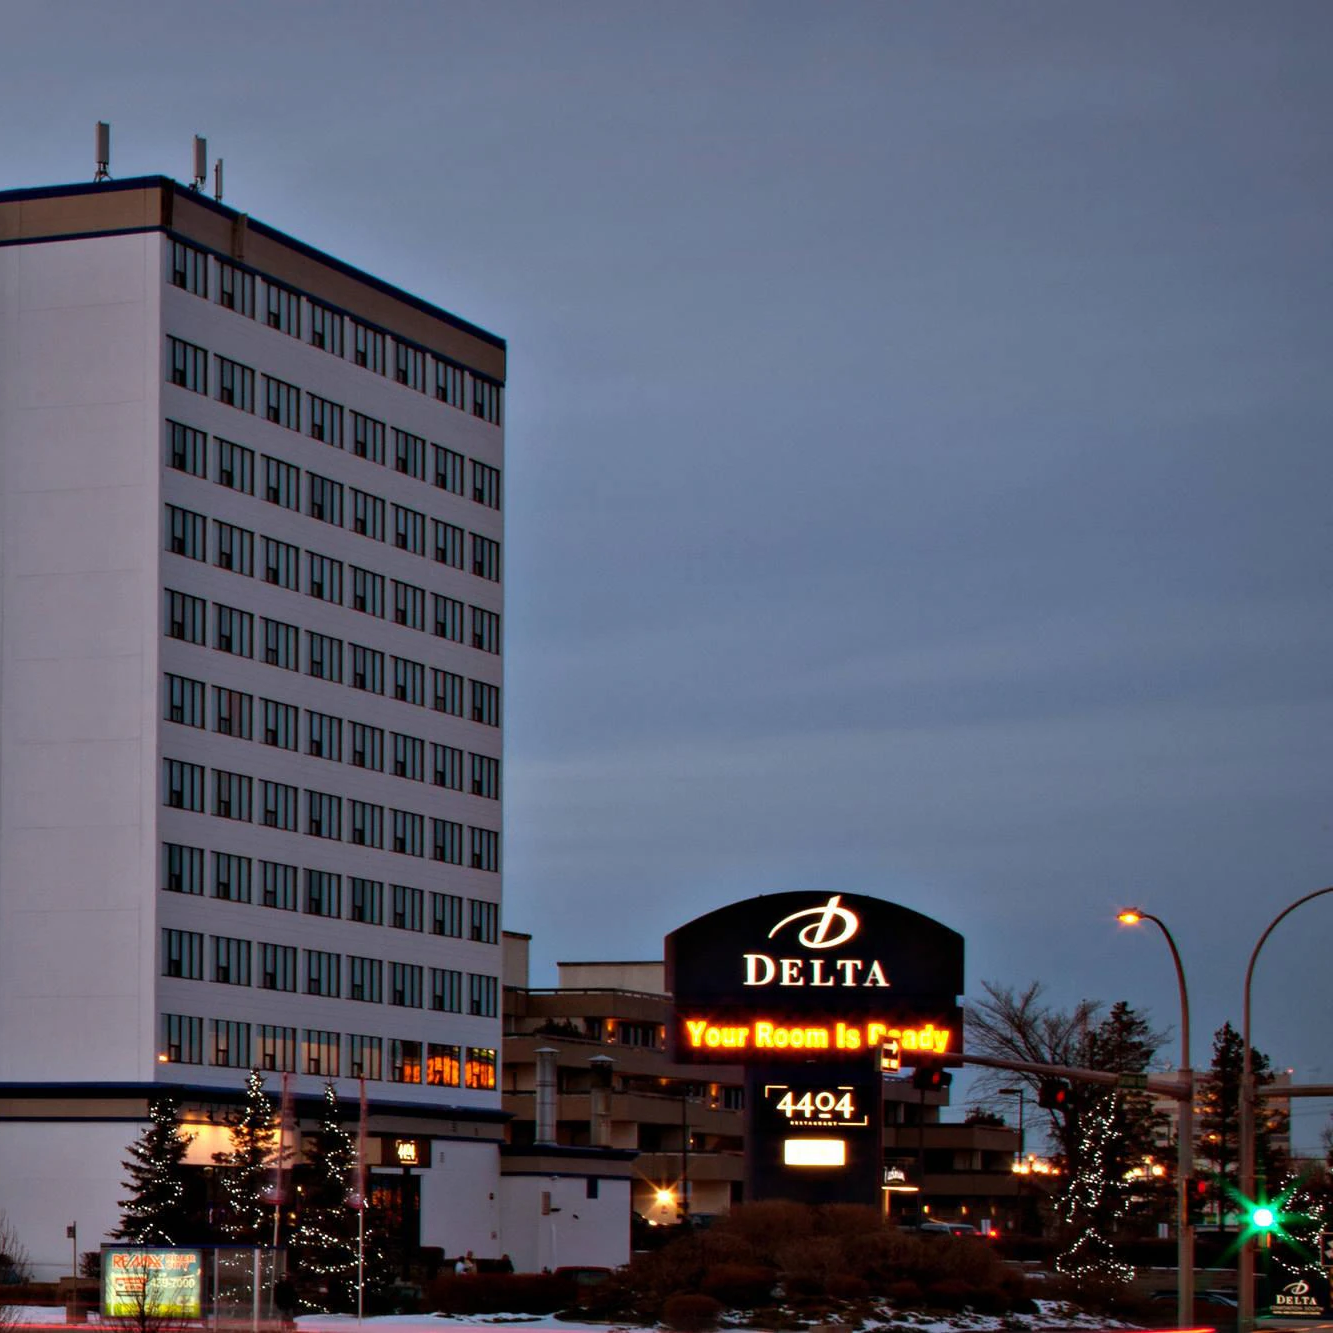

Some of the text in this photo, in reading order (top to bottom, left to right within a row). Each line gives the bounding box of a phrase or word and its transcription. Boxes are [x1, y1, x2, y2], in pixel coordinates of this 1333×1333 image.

[743, 954, 890, 987] DELTA
[686, 1020, 749, 1048] Your
[755, 1021, 829, 1049] Room
[836, 1022, 860, 1049] Is
[776, 1091, 855, 1119] 4404
[1276, 1294, 1317, 1305] DELTA
